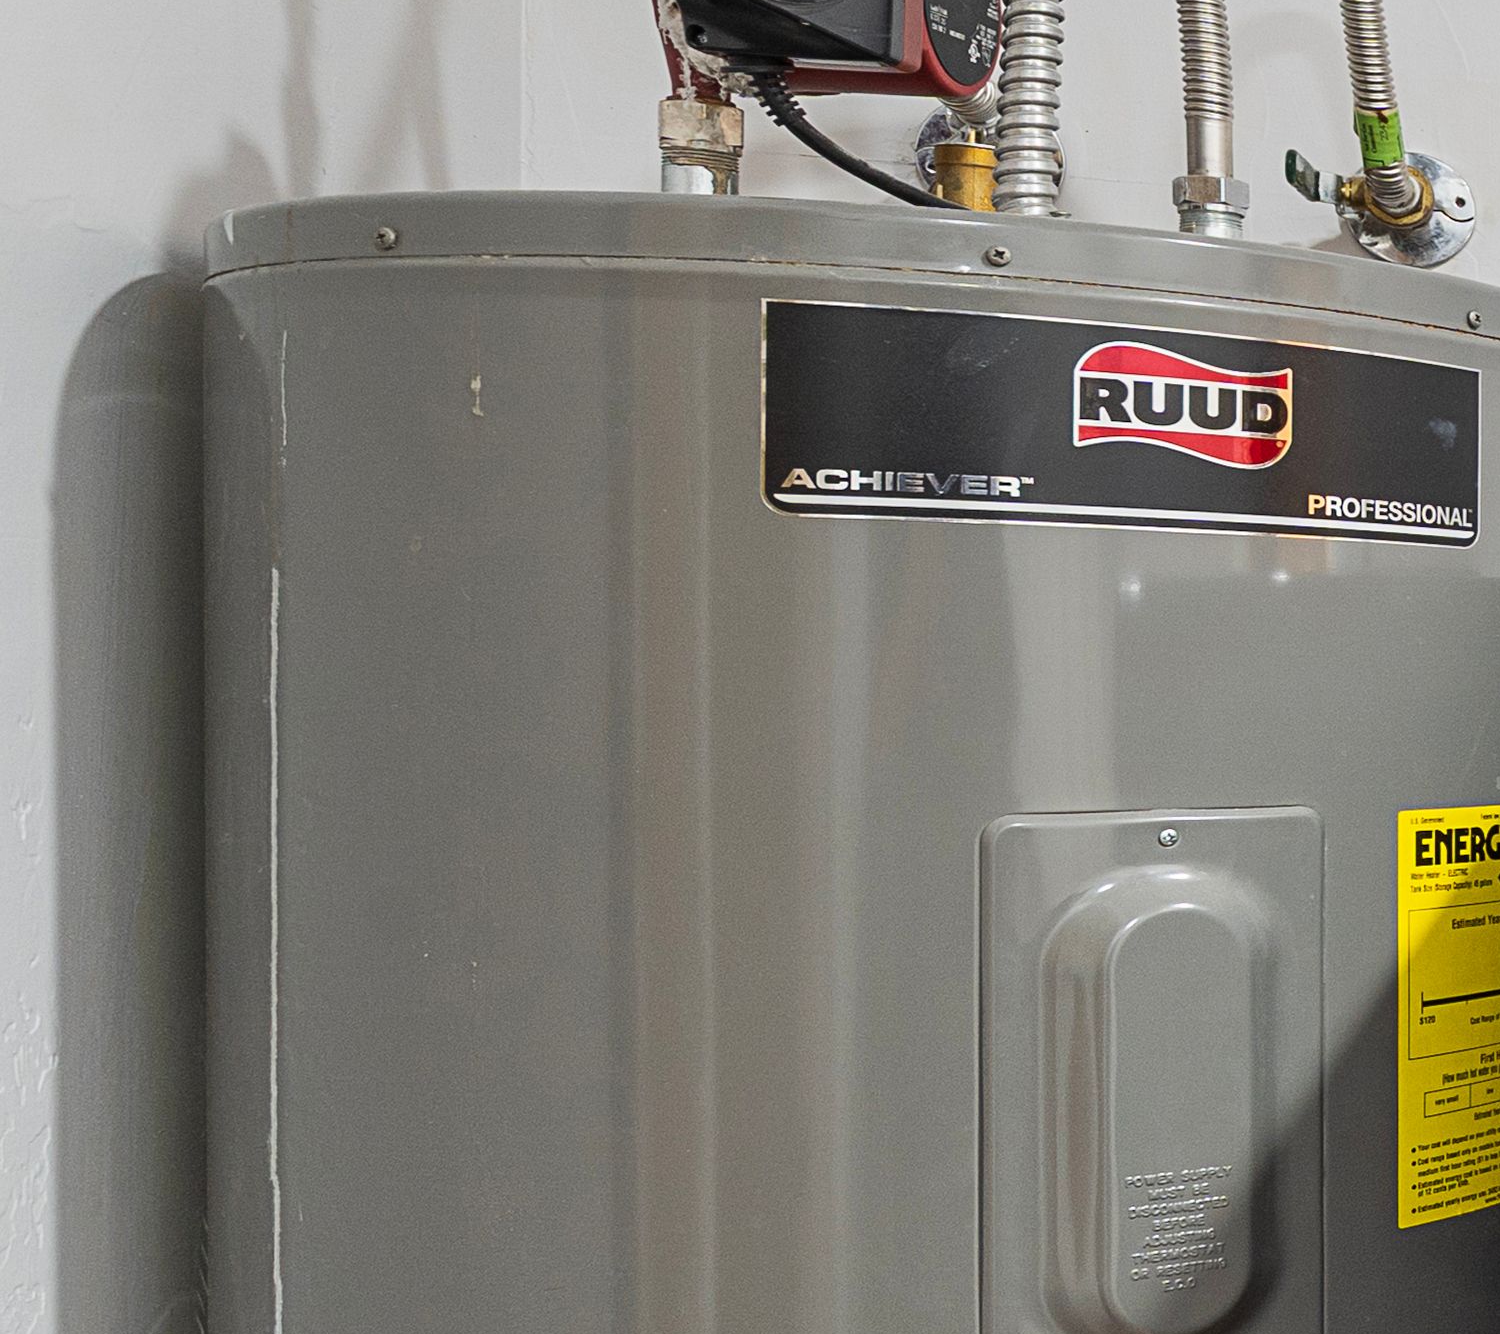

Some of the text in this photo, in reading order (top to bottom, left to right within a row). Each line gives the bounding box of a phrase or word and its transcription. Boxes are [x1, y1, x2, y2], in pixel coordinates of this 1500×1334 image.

[1078, 377, 1287, 434] RUUD
[1452, 917, 1485, 930] Estimated
[1480, 1052, 1494, 1064] First
[1124, 1166, 1232, 1188] POWER SUPPLY
[1148, 1182, 1210, 1201] MUST BE
[1128, 1195, 1229, 1219] DISCONNECTED
[1152, 1214, 1205, 1232] BEFORE
[1142, 1228, 1215, 1248] ADJUSTING
[1132, 1242, 1225, 1265] THERMOSTAT
[1131, 1257, 1226, 1281] OR RESETTING
